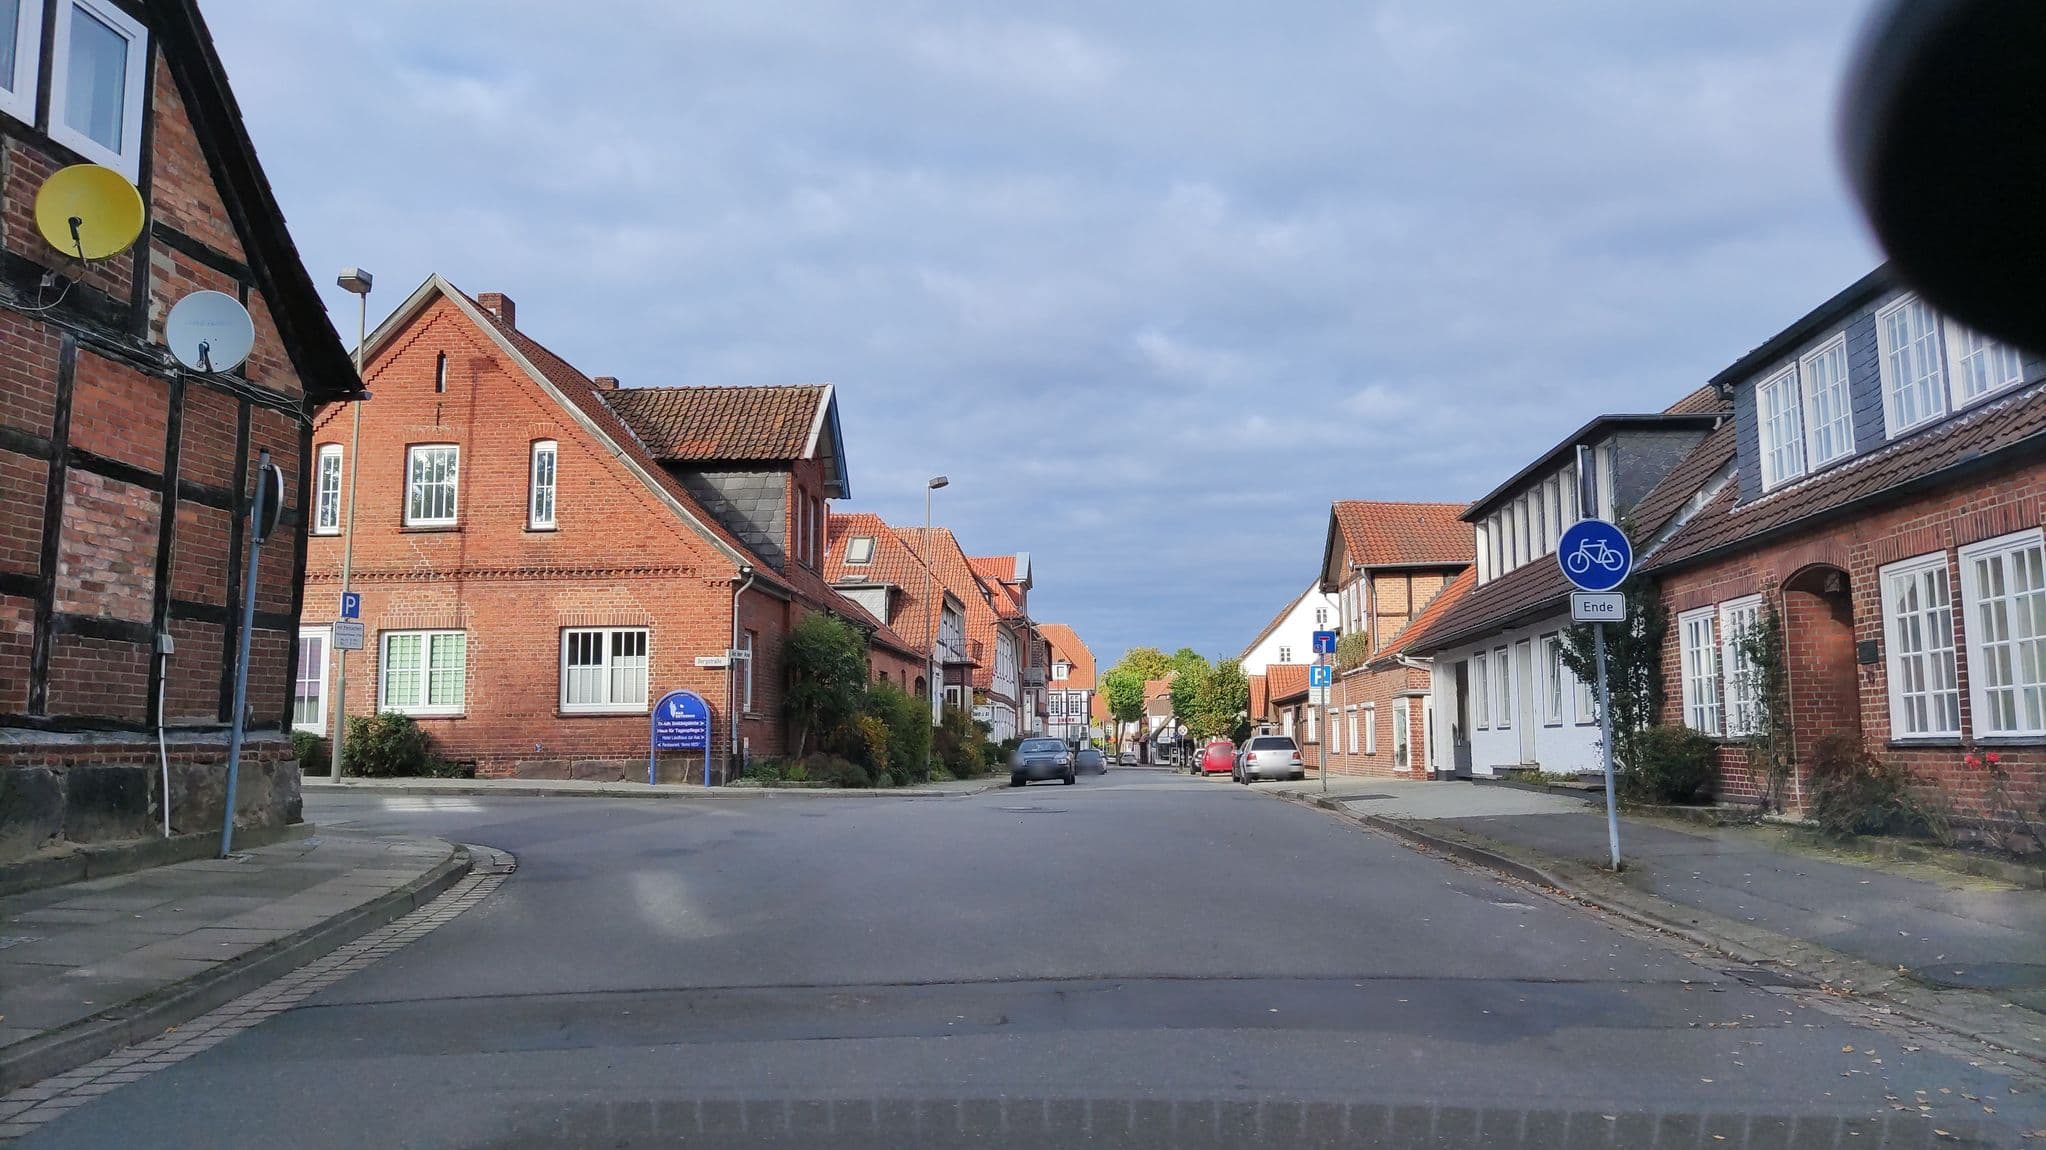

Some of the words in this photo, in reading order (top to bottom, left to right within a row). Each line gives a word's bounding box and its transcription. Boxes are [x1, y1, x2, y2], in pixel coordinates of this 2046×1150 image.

[345, 595, 356, 615] P
[1583, 601, 1614, 612] Ende
[1314, 667, 1327, 685] P
